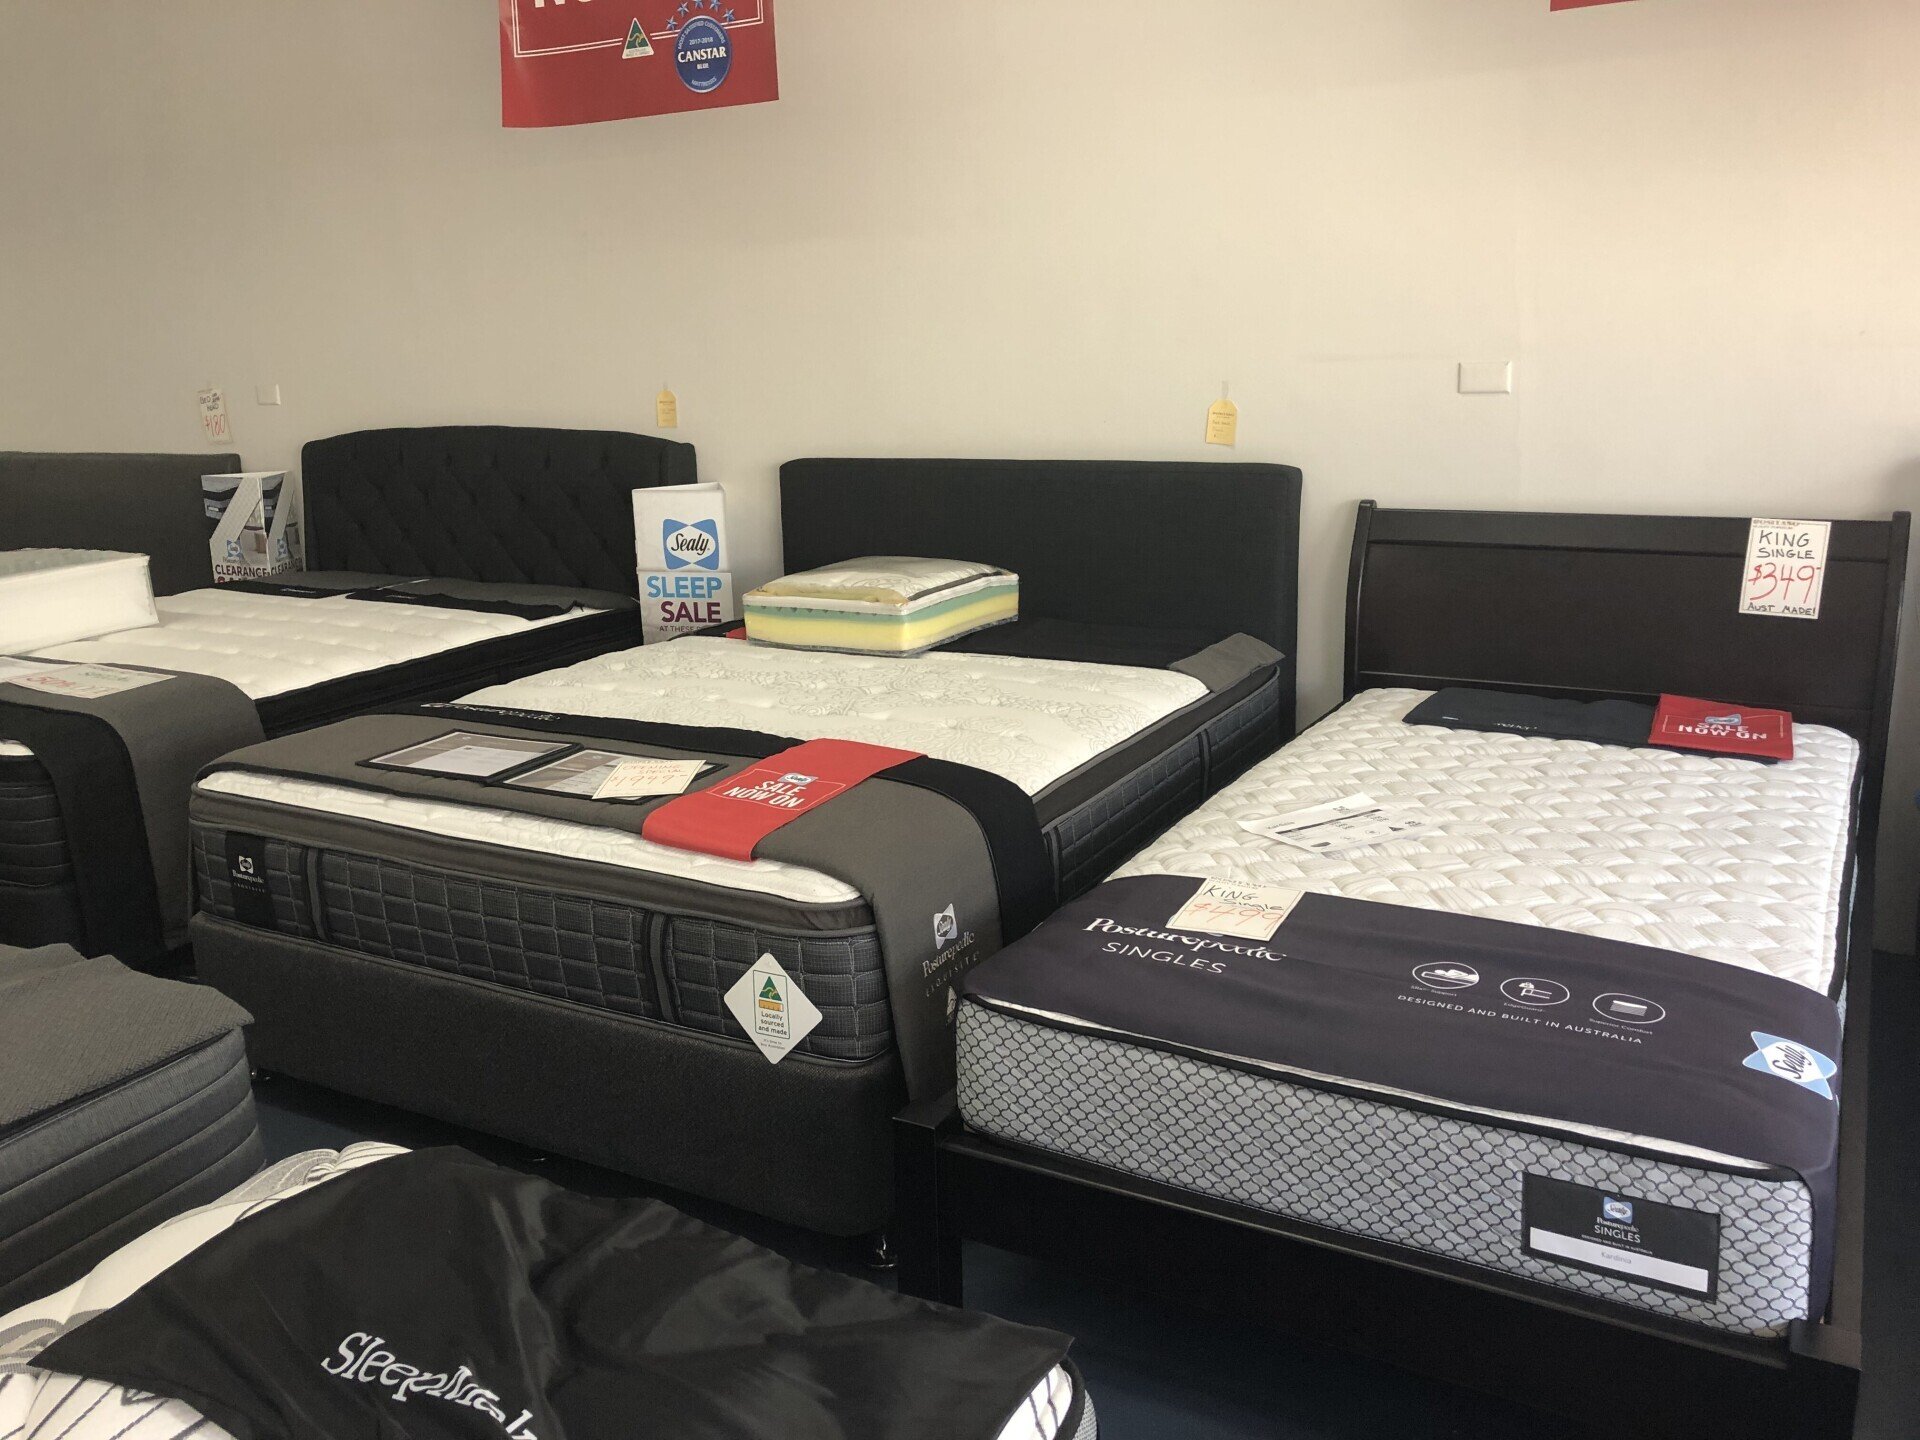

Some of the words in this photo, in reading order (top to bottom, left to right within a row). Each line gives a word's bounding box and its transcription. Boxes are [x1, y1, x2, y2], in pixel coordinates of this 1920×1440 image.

[677, 46, 727, 63] CANSTAR
[670, 533, 710, 556] Sealy
[1759, 530, 1810, 547] KING
[1756, 547, 1815, 560] SINGLE
[215, 564, 267, 578] CLEARANCE
[647, 575, 722, 599] SLEEP
[660, 601, 722, 623] SALE
[1747, 602, 1775, 612] AUST
[1782, 605, 1816, 616] MADE!
[1678, 724, 1729, 736] NOW
[1736, 731, 1767, 740] ON
[722, 786, 776, 801] NOW
[768, 795, 805, 808] ON
[755, 781, 807, 796] SALE
[1203, 885, 1259, 900] KING
[1219, 898, 1284, 912] Single
[1082, 917, 1287, 962] Posturepedic
[921, 931, 976, 978] Posturepedic
[1101, 942, 1228, 974] SINGLES
[760, 1019, 785, 1028] sourced
[761, 1011, 783, 1021] Locally
[1397, 994, 1464, 1011] DESIGNED
[1467, 1007, 1497, 1017] AND
[1501, 1013, 1542, 1025] BUILT
[1545, 1020, 1560, 1029] IN
[1564, 1024, 1642, 1044] AUSTRALIA
[770, 1028, 788, 1036] made
[1772, 1045, 1813, 1079] Sealy
[1594, 1225, 1641, 1244] SINGLES
